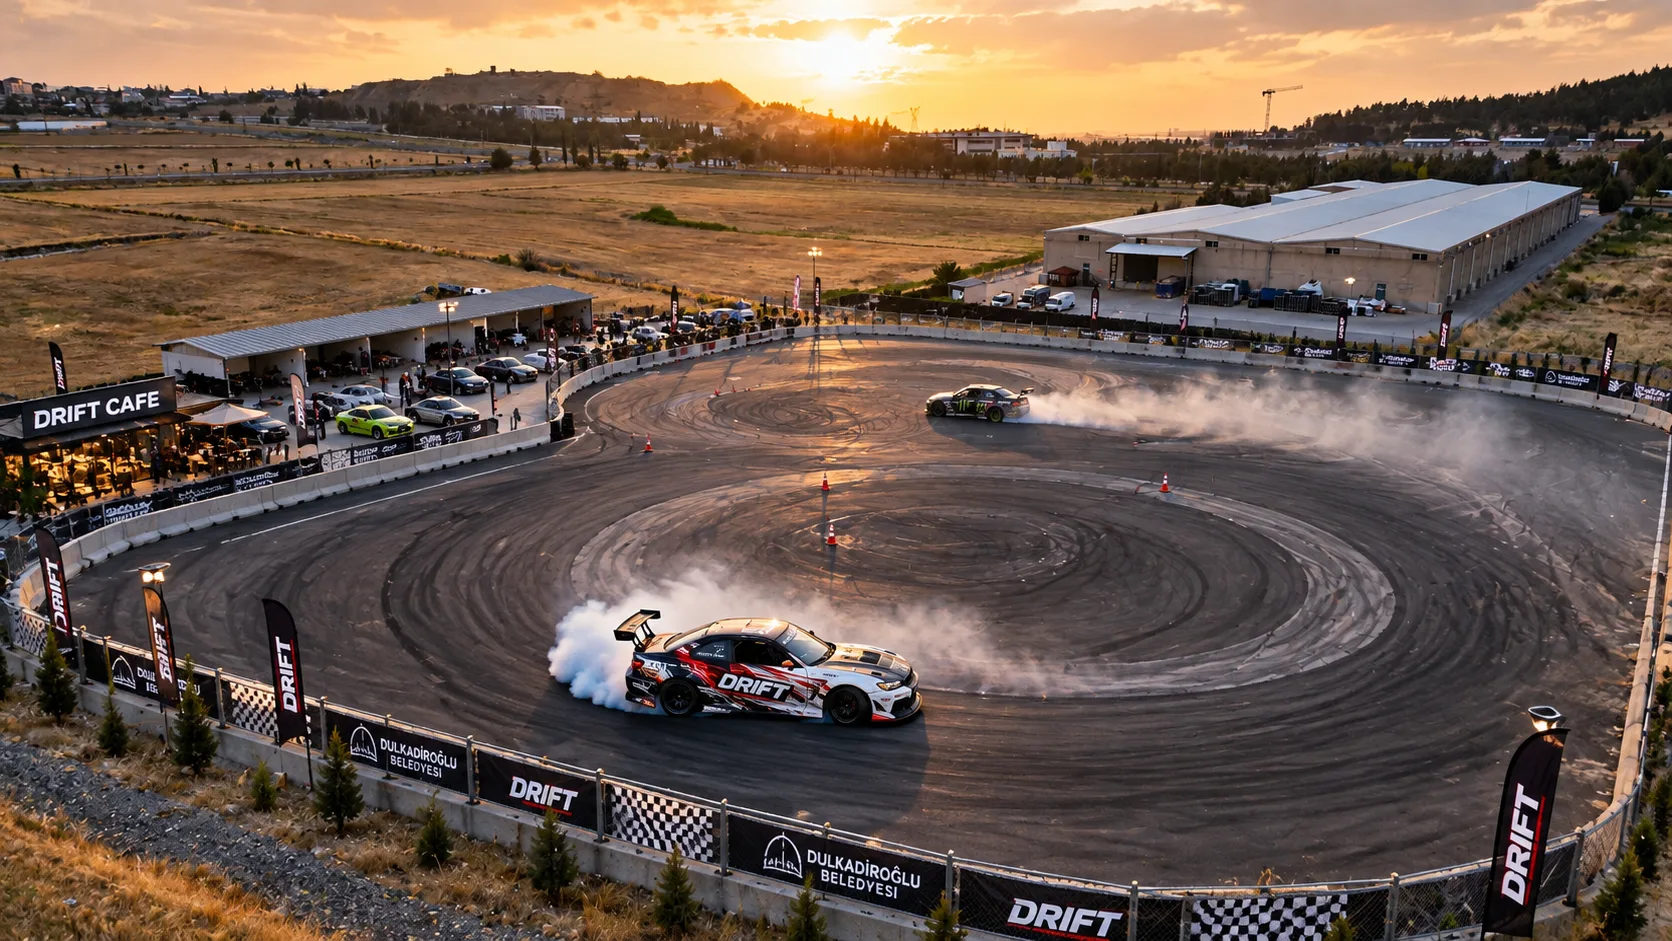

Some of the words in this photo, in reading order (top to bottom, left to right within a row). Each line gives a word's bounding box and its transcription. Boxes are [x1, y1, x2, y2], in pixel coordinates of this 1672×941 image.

[33, 400, 101, 430] DRIFT
[105, 390, 160, 416] CAFE
[45, 557, 68, 633] DRIFT
[274, 635, 298, 713] DRIFT
[717, 673, 791, 700] DRIFT
[509, 775, 579, 812] DRIFT
[1500, 782, 1540, 906] DRIFT
[1006, 897, 1124, 938] DRIFT
